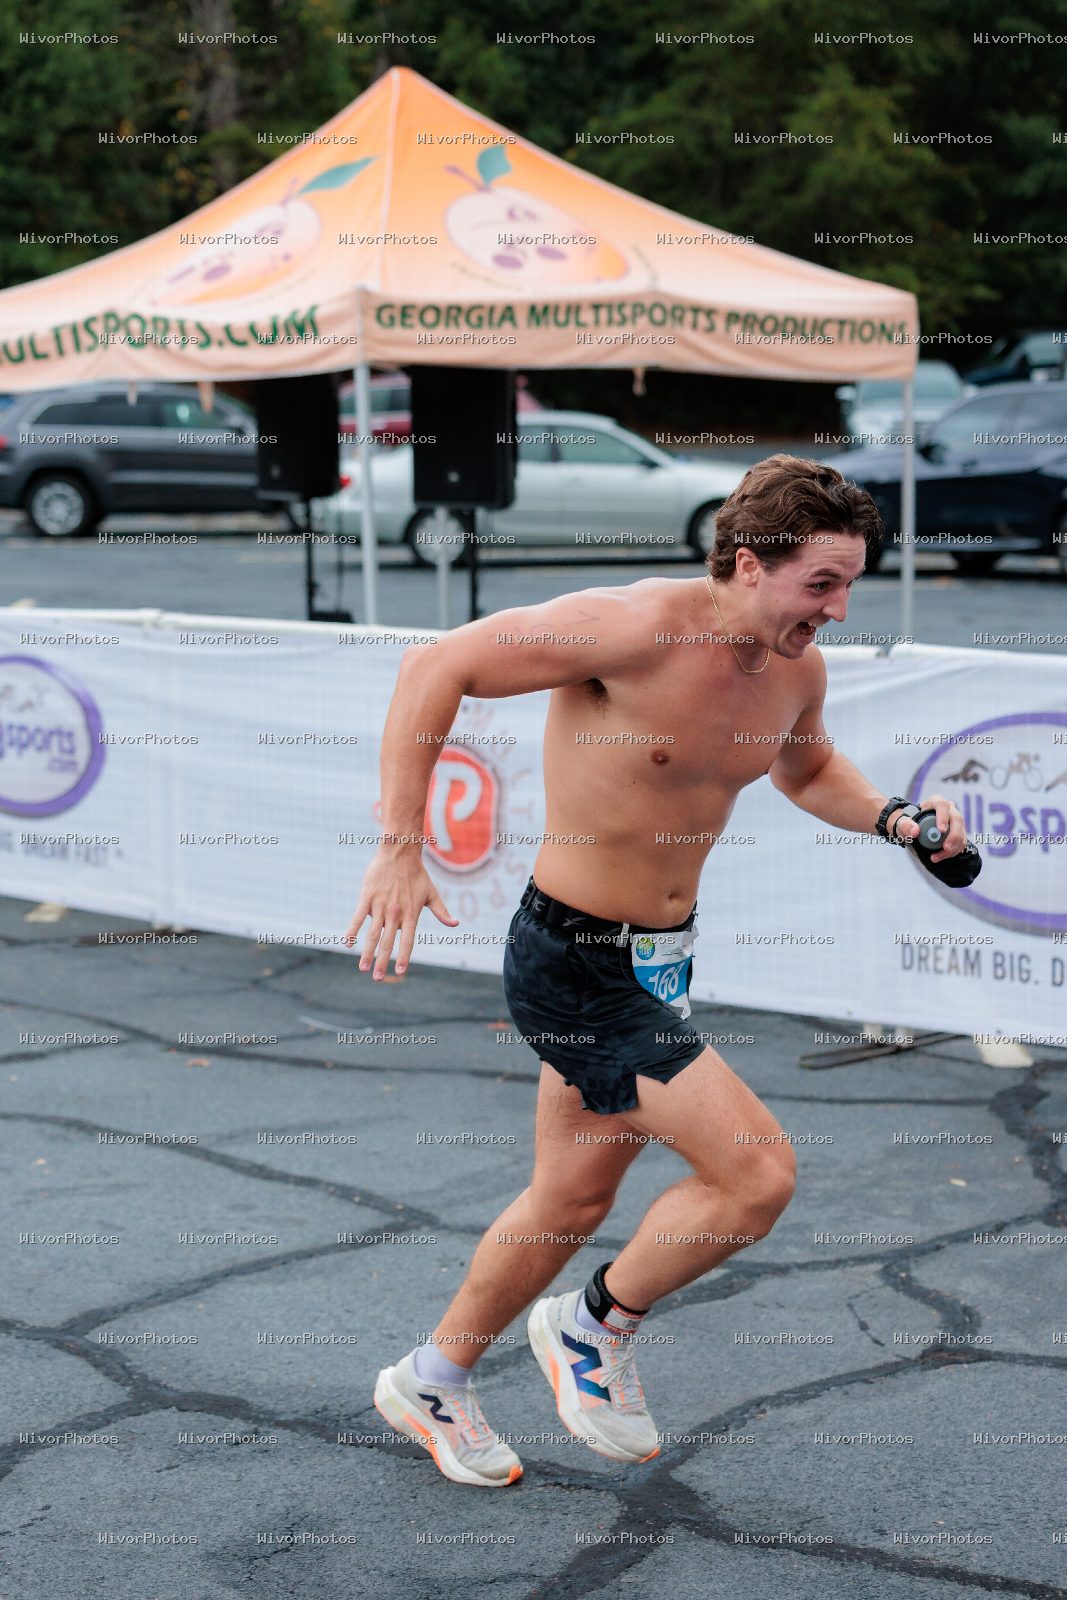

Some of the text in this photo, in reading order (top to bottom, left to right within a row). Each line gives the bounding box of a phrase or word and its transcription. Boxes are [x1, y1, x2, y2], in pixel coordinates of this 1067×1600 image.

[0, 304, 319, 364] ULTISPORTS.COM
[375, 301, 907, 345] GEORGIA MULTISPORTS PRODUCTIONS
[0, 722, 76, 759] sports
[902, 942, 982, 979] DREAM
[993, 951, 1040, 986] BIG.
